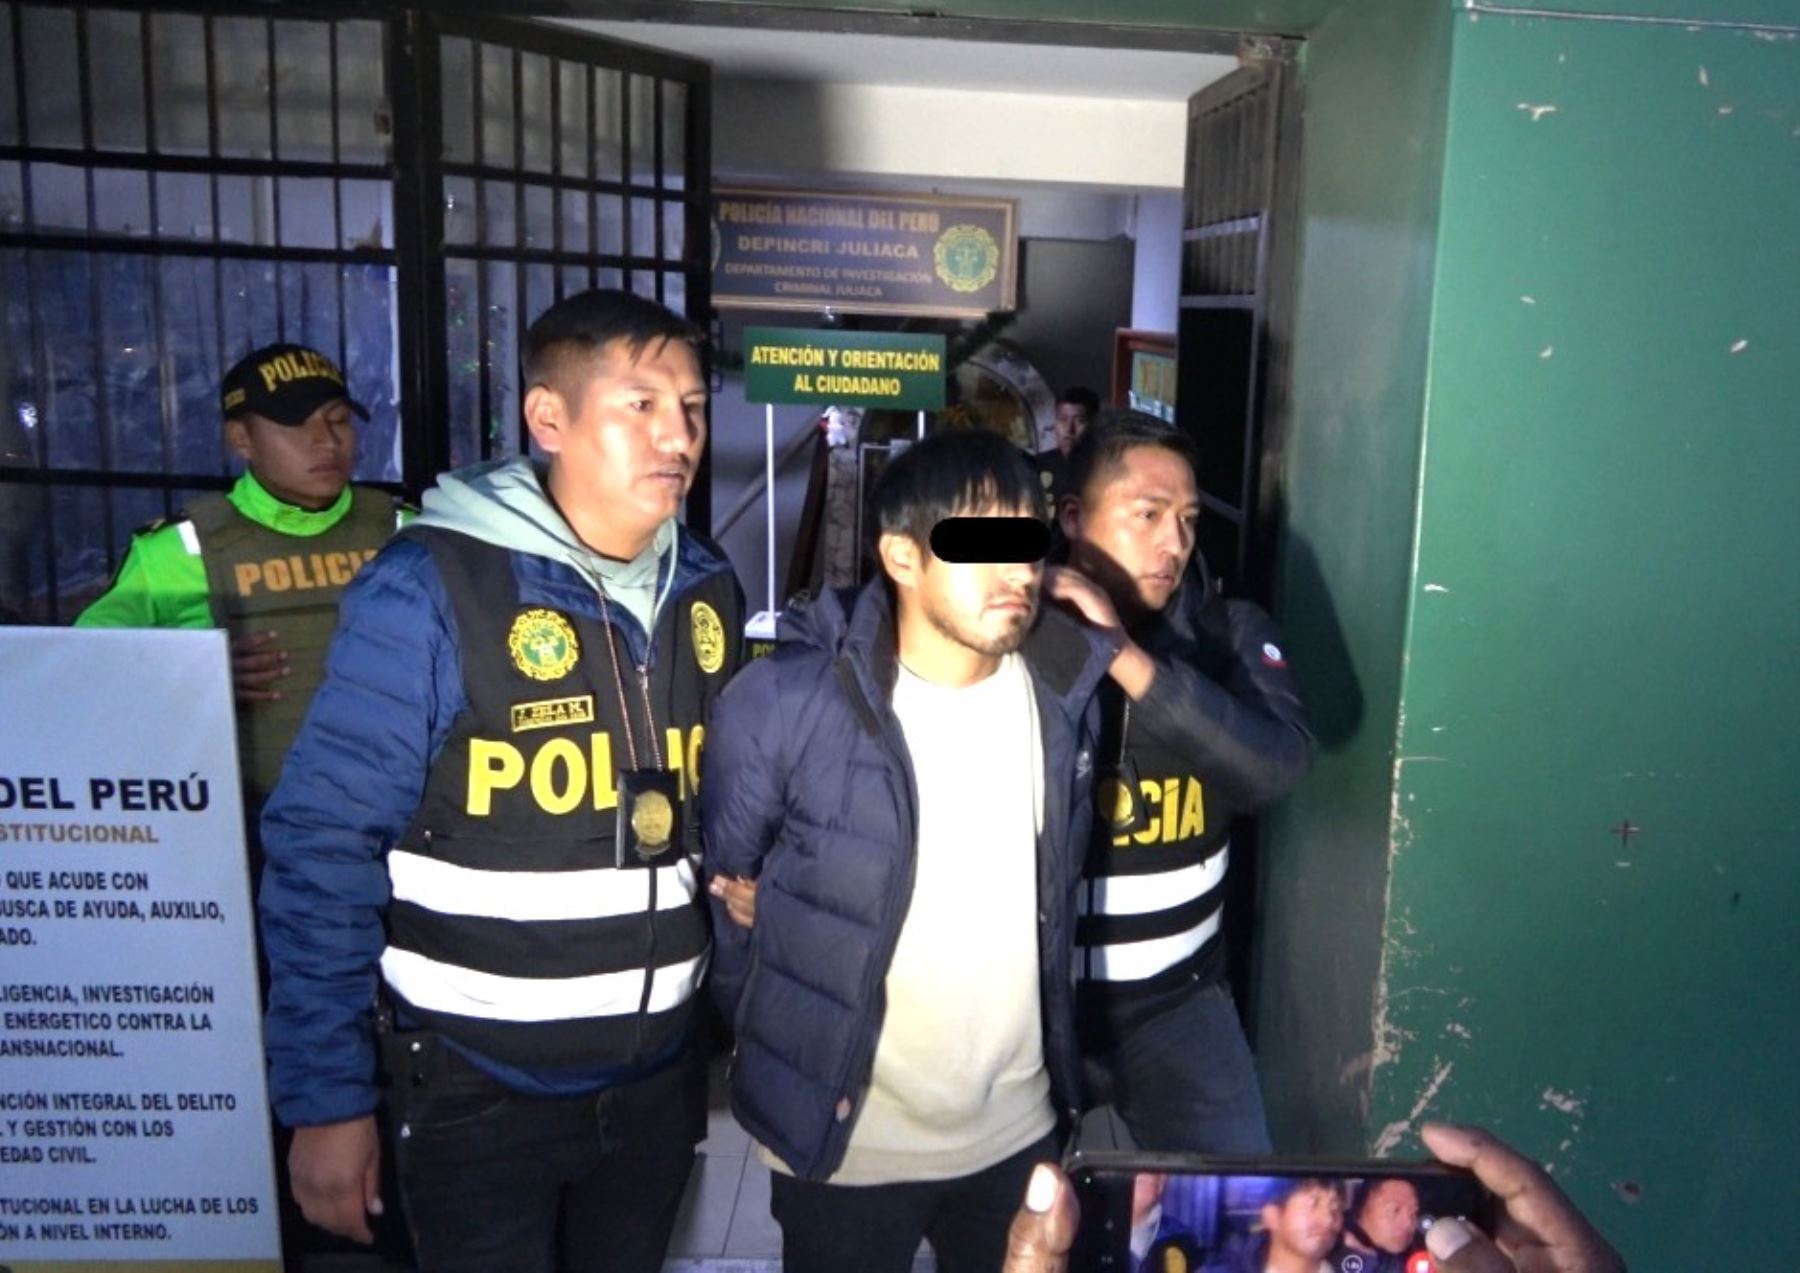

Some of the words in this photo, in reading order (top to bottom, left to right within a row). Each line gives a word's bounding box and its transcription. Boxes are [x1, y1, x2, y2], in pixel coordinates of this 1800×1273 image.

[785, 205, 864, 229] NACIONAL
[869, 210, 895, 230] DEL
[737, 235, 830, 255] DEPINCRI
[836, 241, 919, 259] JULIACA
[725, 262, 821, 278] DEPARTAMENTO
[824, 267, 838, 279] DE
[774, 282, 831, 297] CRIMINAL
[835, 284, 882, 297] JULIACA
[752, 345, 824, 367] ATENCIÓN
[828, 350, 839, 367] Y
[841, 350, 940, 371] ORIENTACIÓN
[794, 374, 813, 392] AL
[816, 376, 901, 396] CIUDADANO
[0, 776, 75, 810] DEL
[90, 772, 210, 812] PERÚ
[1113, 774, 1204, 847] CIA
[6, 870, 43, 891] QUE
[48, 871, 107, 890] ACUDE
[112, 872, 149, 891] CON
[0, 899, 50, 918] USCA
[54, 900, 77, 918] DE
[82, 901, 146, 922] AYUDA,
[150, 902, 225, 923] AUXILIO,
[0, 985, 79, 1006] IGENCIA,
[83, 982, 214, 1004] INVESTIGACIÓN
[117, 1012, 186, 1031] CONTRA
[191, 1014, 212, 1031] LA
[0, 1039, 124, 1058] ANSNACIONAL.
[53, 1092, 137, 1111] INTEGRAL
[142, 1094, 173, 1111] DEL
[178, 1094, 236, 1111] DELITO
[7, 1120, 17, 1137] Y
[23, 1117, 97, 1137] GESTIÓN
[102, 1120, 137, 1137] CON
[142, 1120, 174, 1137] LOS
[0, 1146, 43, 1163] EDAD
[48, 1146, 97, 1164] CIVIL.
[88, 1197, 109, 1215] EN
[116, 1198, 136, 1214] LA
[141, 1198, 196, 1215] LUCHA
[201, 1198, 222, 1214] DE
[227, 1197, 259, 1214] LOS
[24, 1224, 37, 1240] A
[41, 1224, 89, 1240] NIVEL
[94, 1224, 172, 1241] INTERNO.
